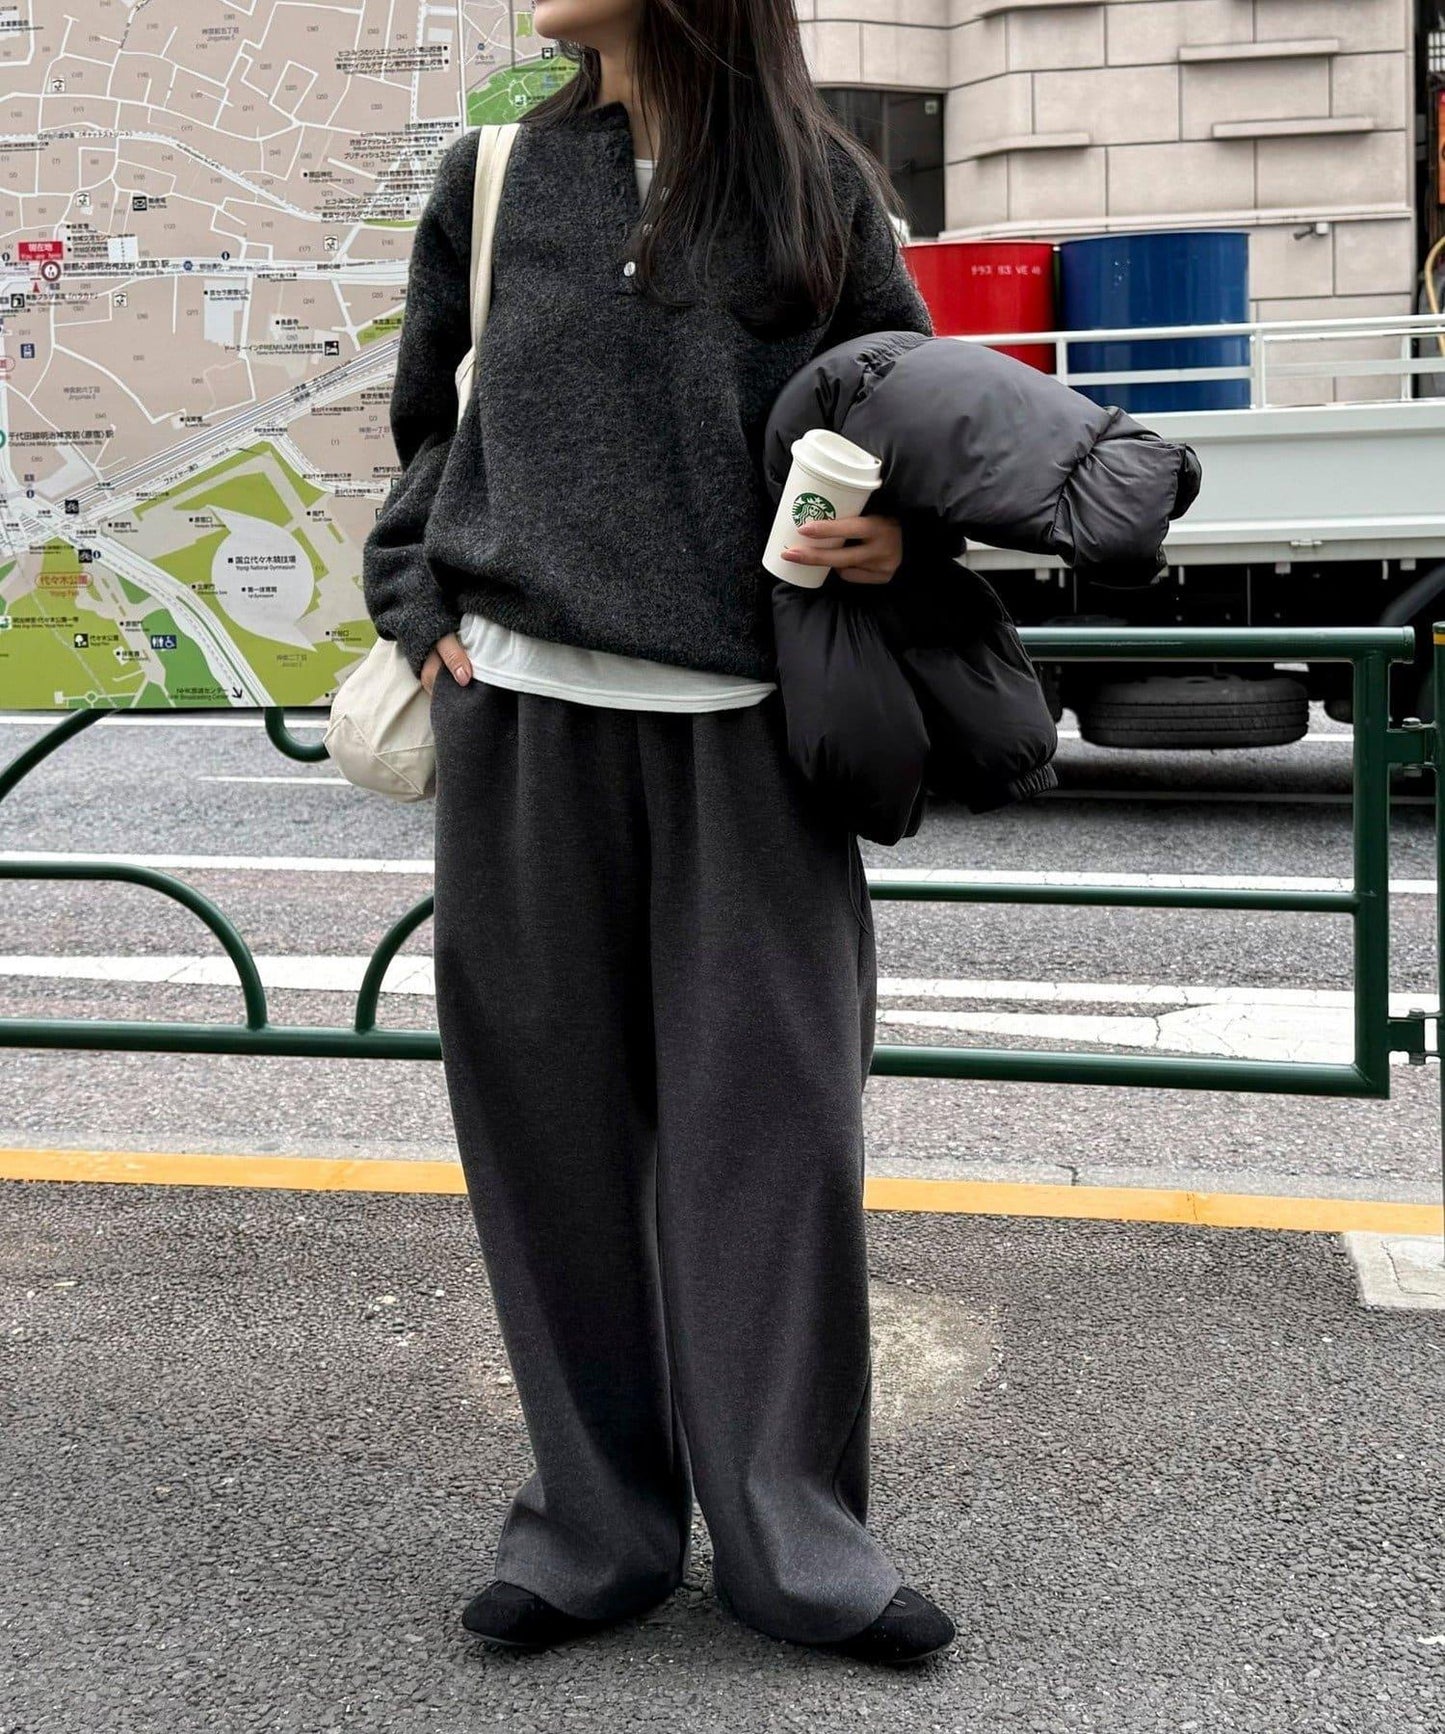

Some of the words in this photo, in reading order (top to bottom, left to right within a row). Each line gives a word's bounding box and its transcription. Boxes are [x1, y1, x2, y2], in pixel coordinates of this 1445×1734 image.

[235, 555, 297, 565] 国立代々木競技場
[41, 575, 88, 585] 代々木公園
